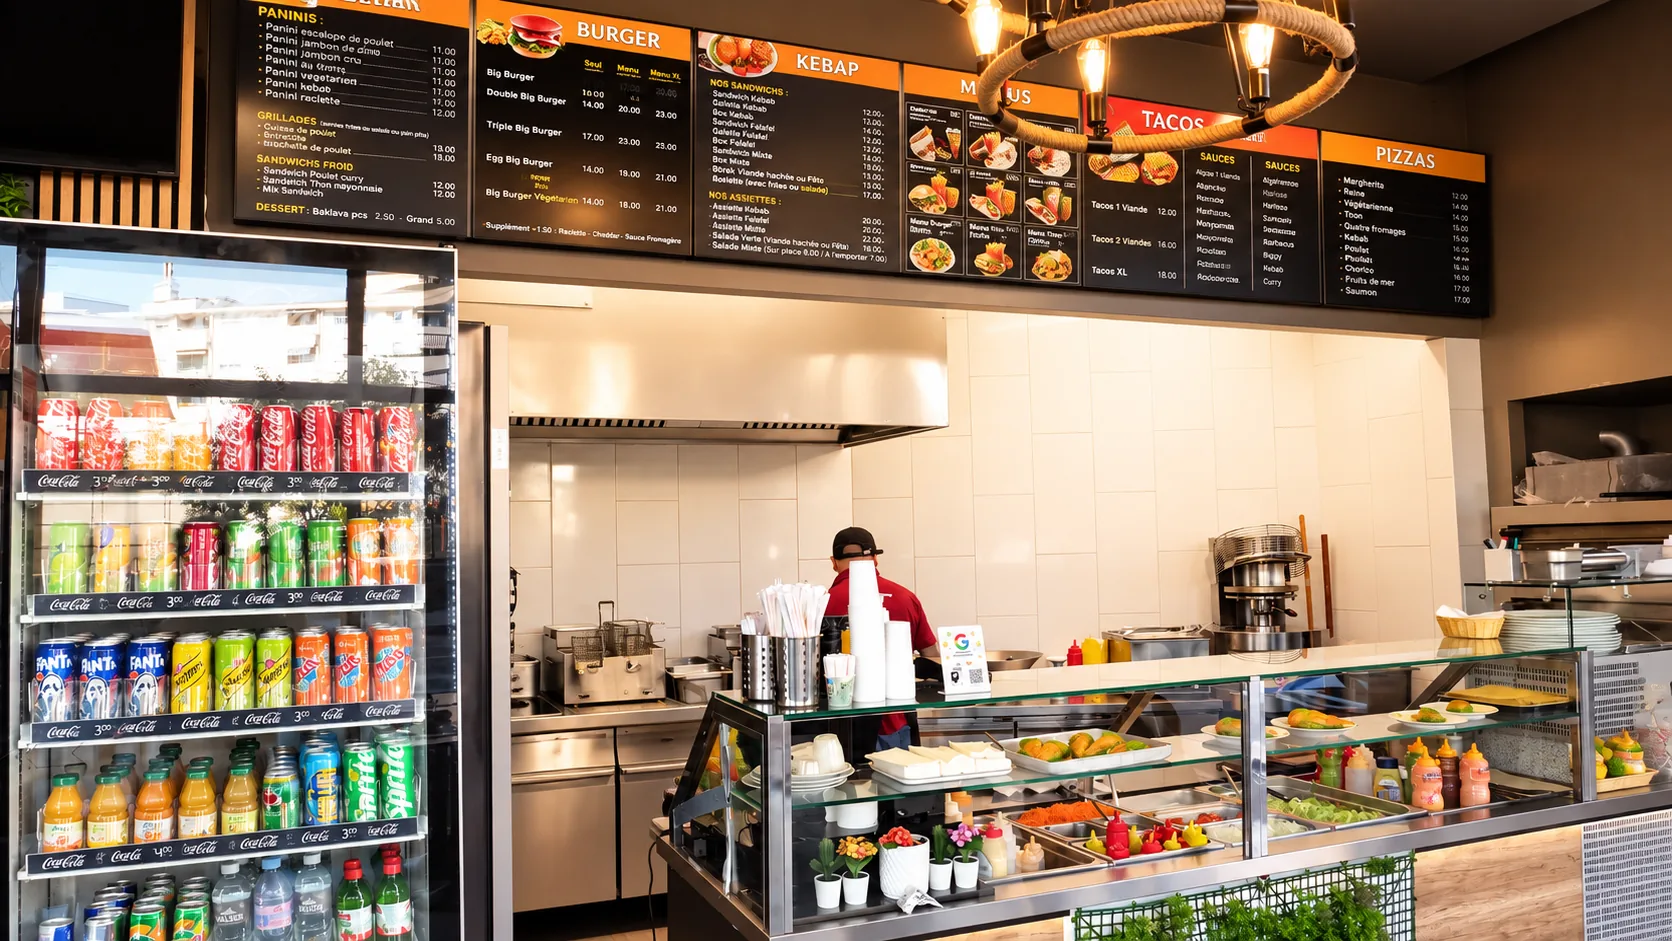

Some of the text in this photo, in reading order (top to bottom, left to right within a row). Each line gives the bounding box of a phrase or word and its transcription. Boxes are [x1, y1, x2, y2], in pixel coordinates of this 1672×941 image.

[258, 6, 317, 24] PANINIS
[266, 22, 298, 34] Panini
[432, 46, 456, 56] 11.00
[576, 21, 661, 50] BURGER
[266, 32, 298, 45] Panini
[432, 56, 456, 67] 11.00
[266, 43, 298, 56] Panini
[266, 54, 298, 67] Panini
[796, 53, 860, 77] KEBAP
[266, 66, 298, 79] Panini
[486, 68, 535, 82] Big Burger
[266, 77, 298, 90] Panini
[731, 81, 784, 97] SANDWICHS
[266, 89, 298, 101] Panini
[960, 79, 1032, 105] MUS
[486, 88, 518, 99] Double
[520, 92, 535, 102] Big
[537, 94, 567, 106] Burger
[582, 100, 605, 110] 14.00
[618, 105, 641, 115] 20.00
[257, 111, 317, 125] GRILLADES
[1141, 109, 1205, 131] TACOS
[486, 120, 513, 132] Triple
[515, 124, 530, 134] Big
[532, 126, 563, 137] Burger
[582, 132, 605, 142] 17.00
[256, 154, 354, 171] SANDWICHS FROID
[486, 153, 503, 164] Egg
[505, 155, 521, 166] Big
[523, 157, 553, 169] Burger
[1200, 152, 1236, 165] SAUCES
[1376, 146, 1436, 169] PIZZAS
[1265, 161, 1301, 173] SAUCES
[486, 188, 500, 199] Big
[502, 190, 533, 201] Burger
[256, 202, 306, 214] DESSERT
[406, 215, 434, 224] Grand
[436, 217, 456, 226] 5.00
[1091, 201, 1114, 211] Tacos
[1091, 234, 1114, 244] Tacos
[1091, 266, 1114, 276] Tacos
[1117, 267, 1128, 276] XL
